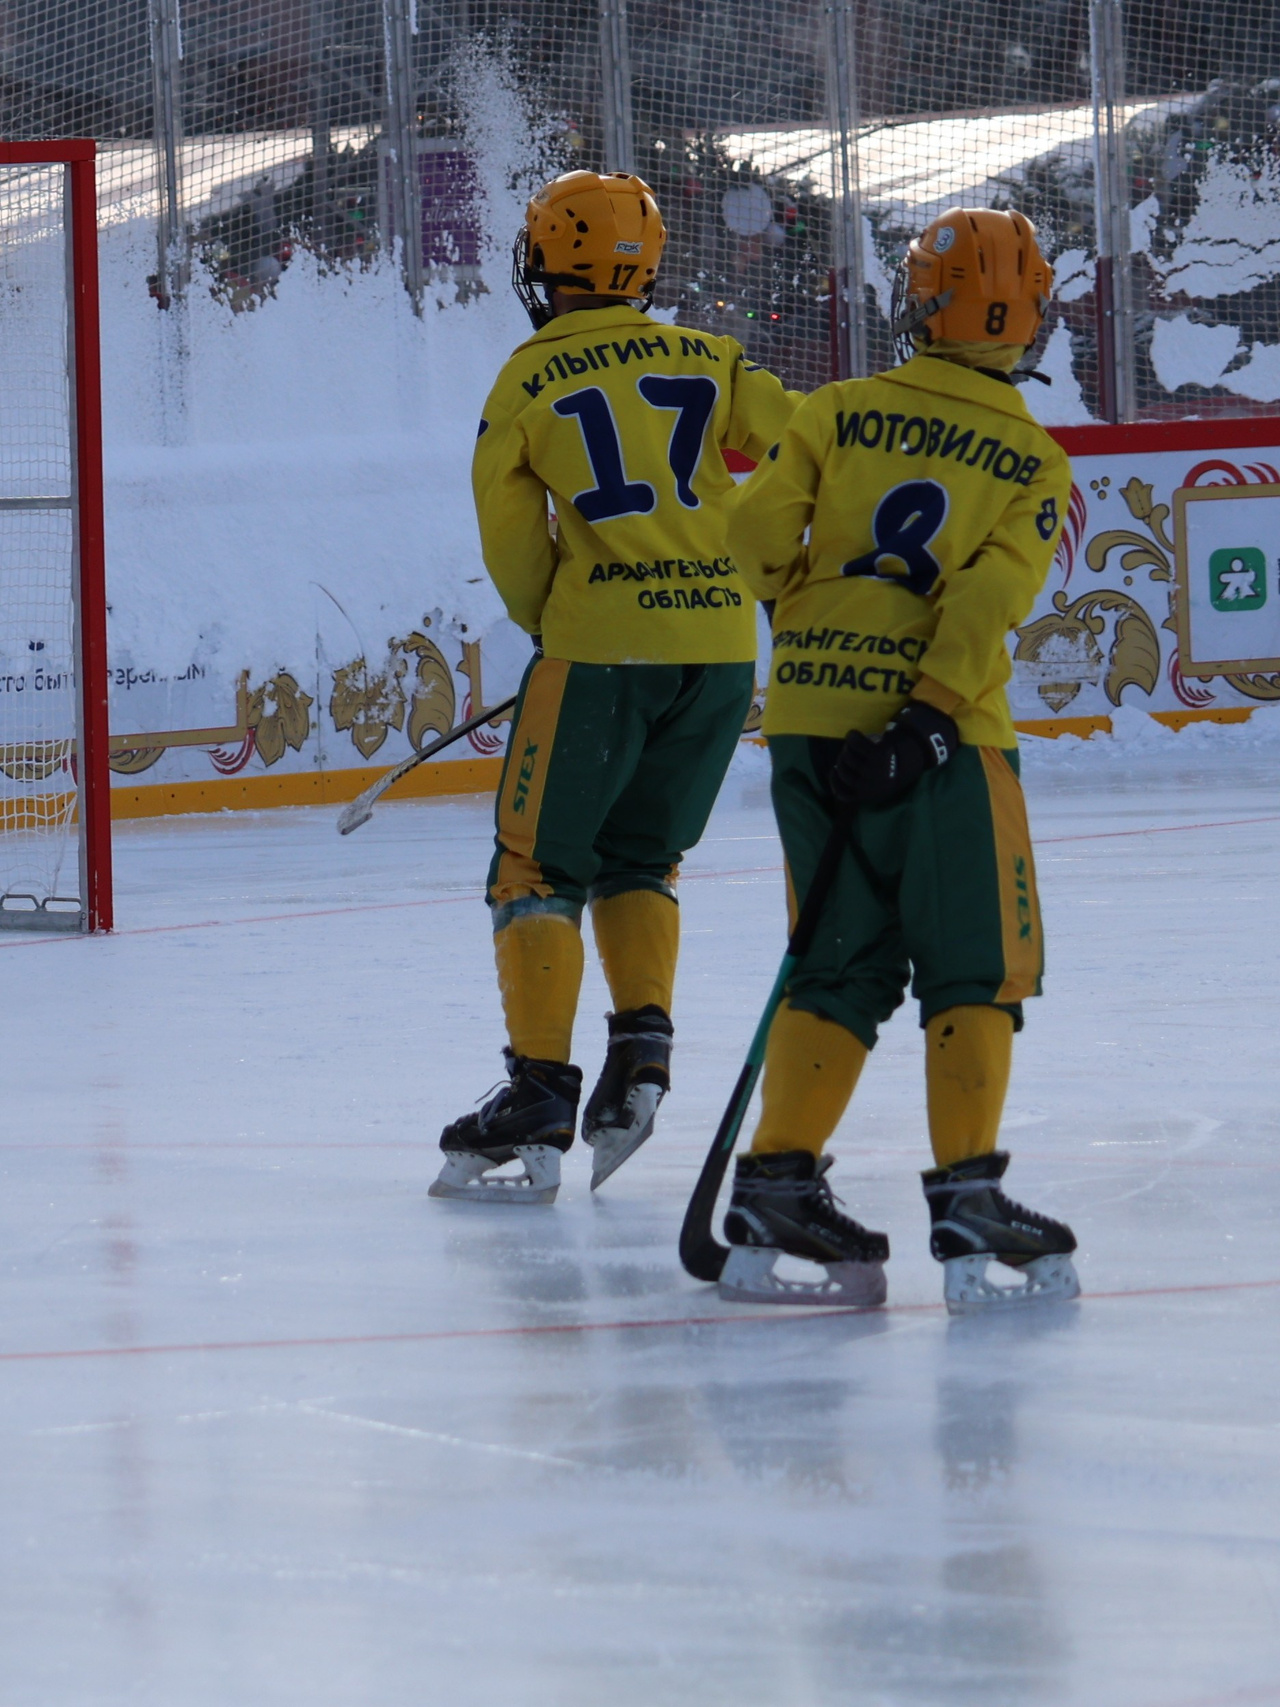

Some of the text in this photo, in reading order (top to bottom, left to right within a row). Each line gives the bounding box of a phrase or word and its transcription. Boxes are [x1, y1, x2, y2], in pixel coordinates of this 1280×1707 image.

[609, 264, 639, 290] 17
[985, 303, 1008, 335] 8
[522, 336, 720, 397] КЛЫГИН М.
[552, 374, 718, 523] 17
[841, 478, 949, 595] 8
[1035, 497, 1058, 540] 8
[638, 586, 741, 609] ОБЛАСТЬ
[777, 661, 916, 695] ОБЛАСТЬ
